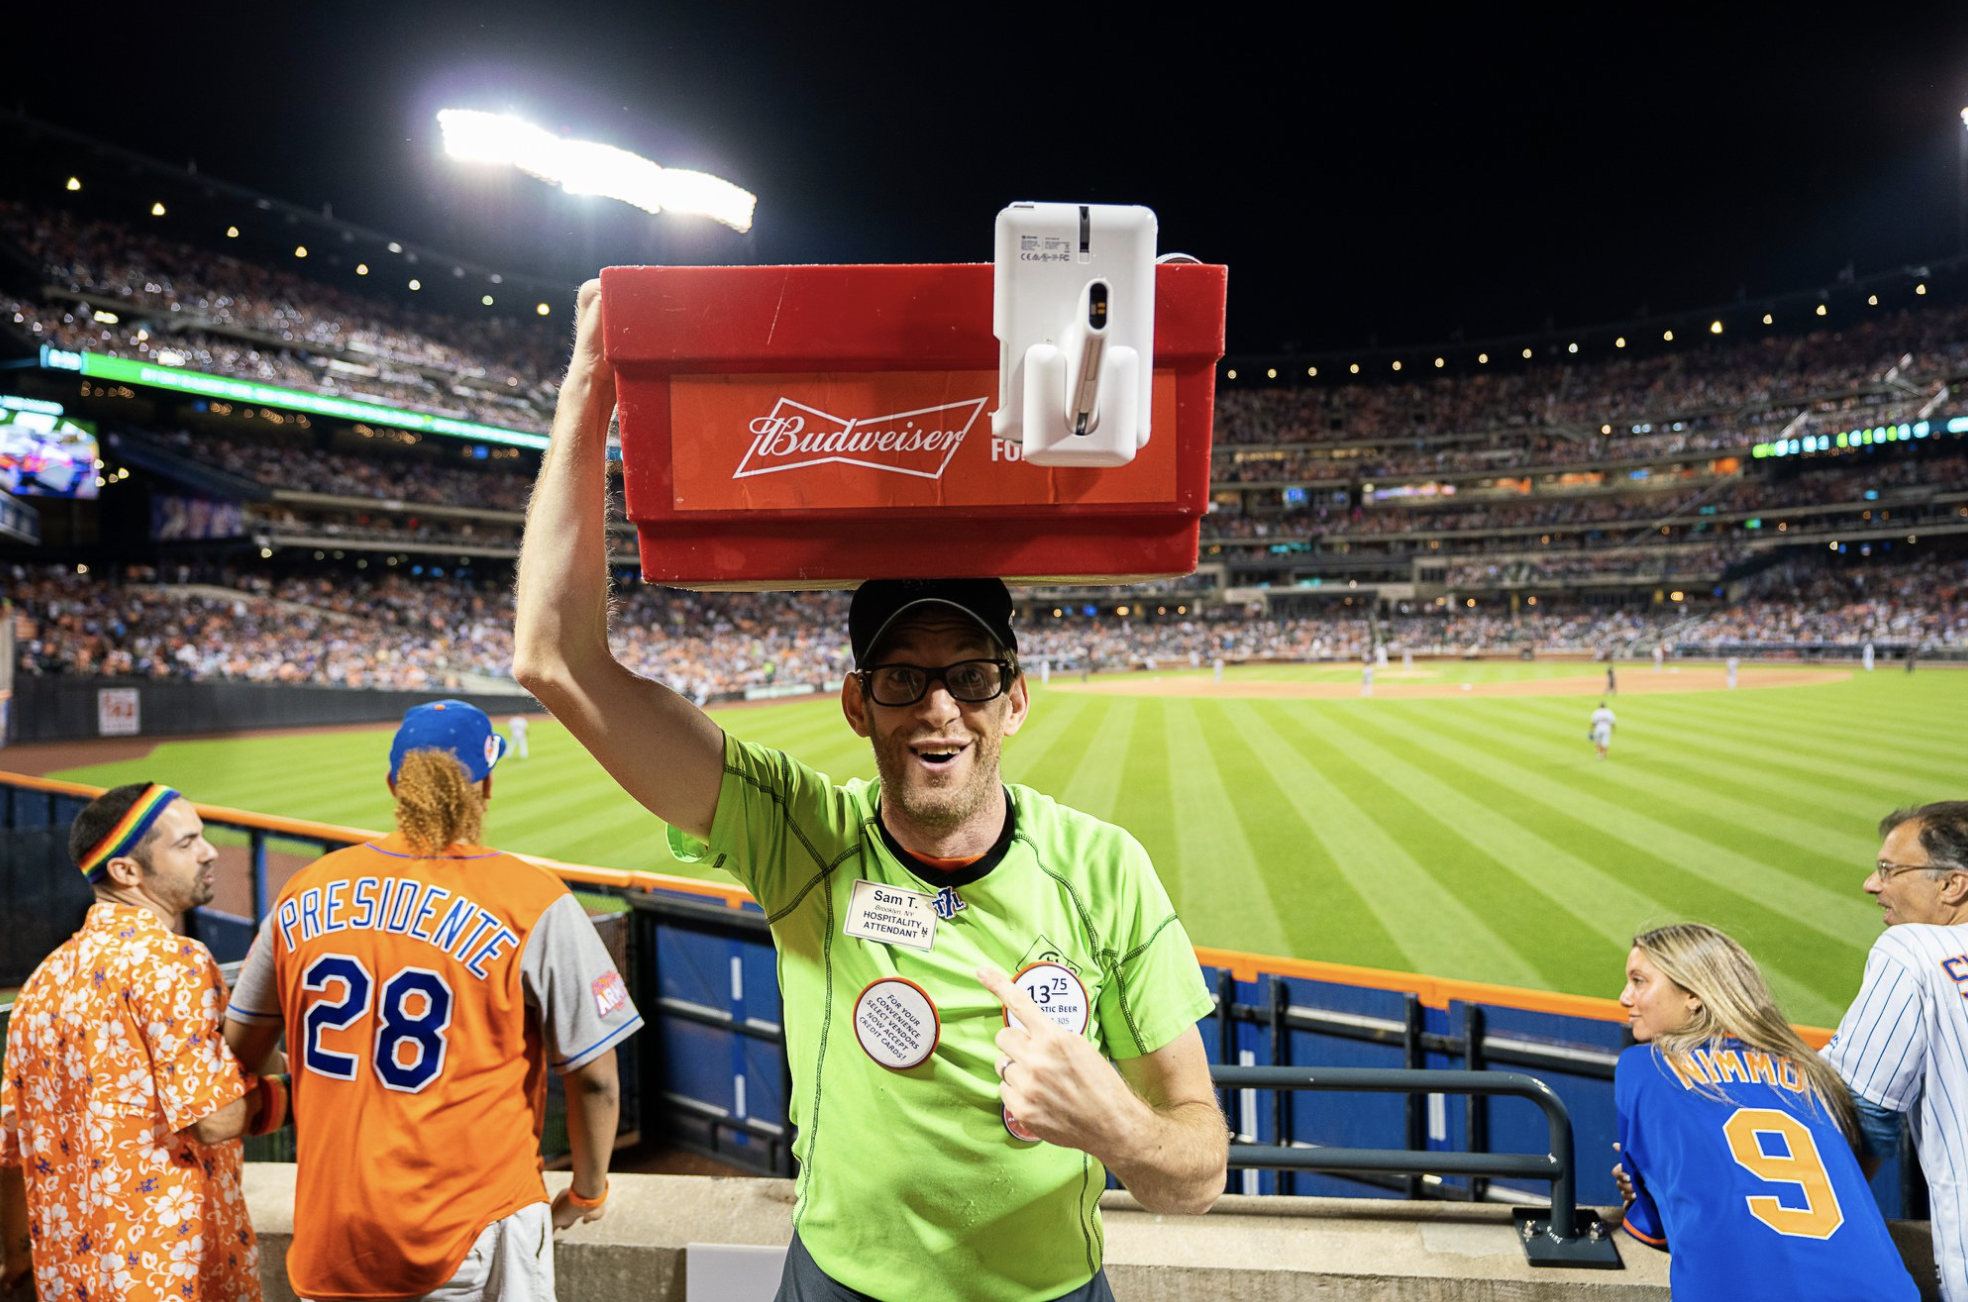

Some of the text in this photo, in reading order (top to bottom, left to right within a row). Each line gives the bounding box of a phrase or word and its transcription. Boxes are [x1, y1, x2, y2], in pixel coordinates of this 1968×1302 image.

[749, 415, 964, 456] Budweiser
[991, 437, 1025, 462] FO
[863, 910, 922, 929] HOSPITALITY
[873, 889, 918, 909] Sam T.
[277, 876, 521, 981] PRESIDENTE
[863, 921, 918, 939] ATTENDANT
[596, 979, 626, 1016] ARM
[876, 996, 921, 1039] CONVENIENCE
[887, 994, 921, 1027] FOR YOUR
[302, 952, 453, 1094] 28
[859, 1016, 907, 1061] CREDIT CARDS!
[866, 999, 920, 1050] SELECT VENDORS
[866, 1012, 909, 1051] NOW ACCEPT
[1663, 1049, 1804, 1093] NIMMO
[1722, 1107, 1845, 1240] 9
